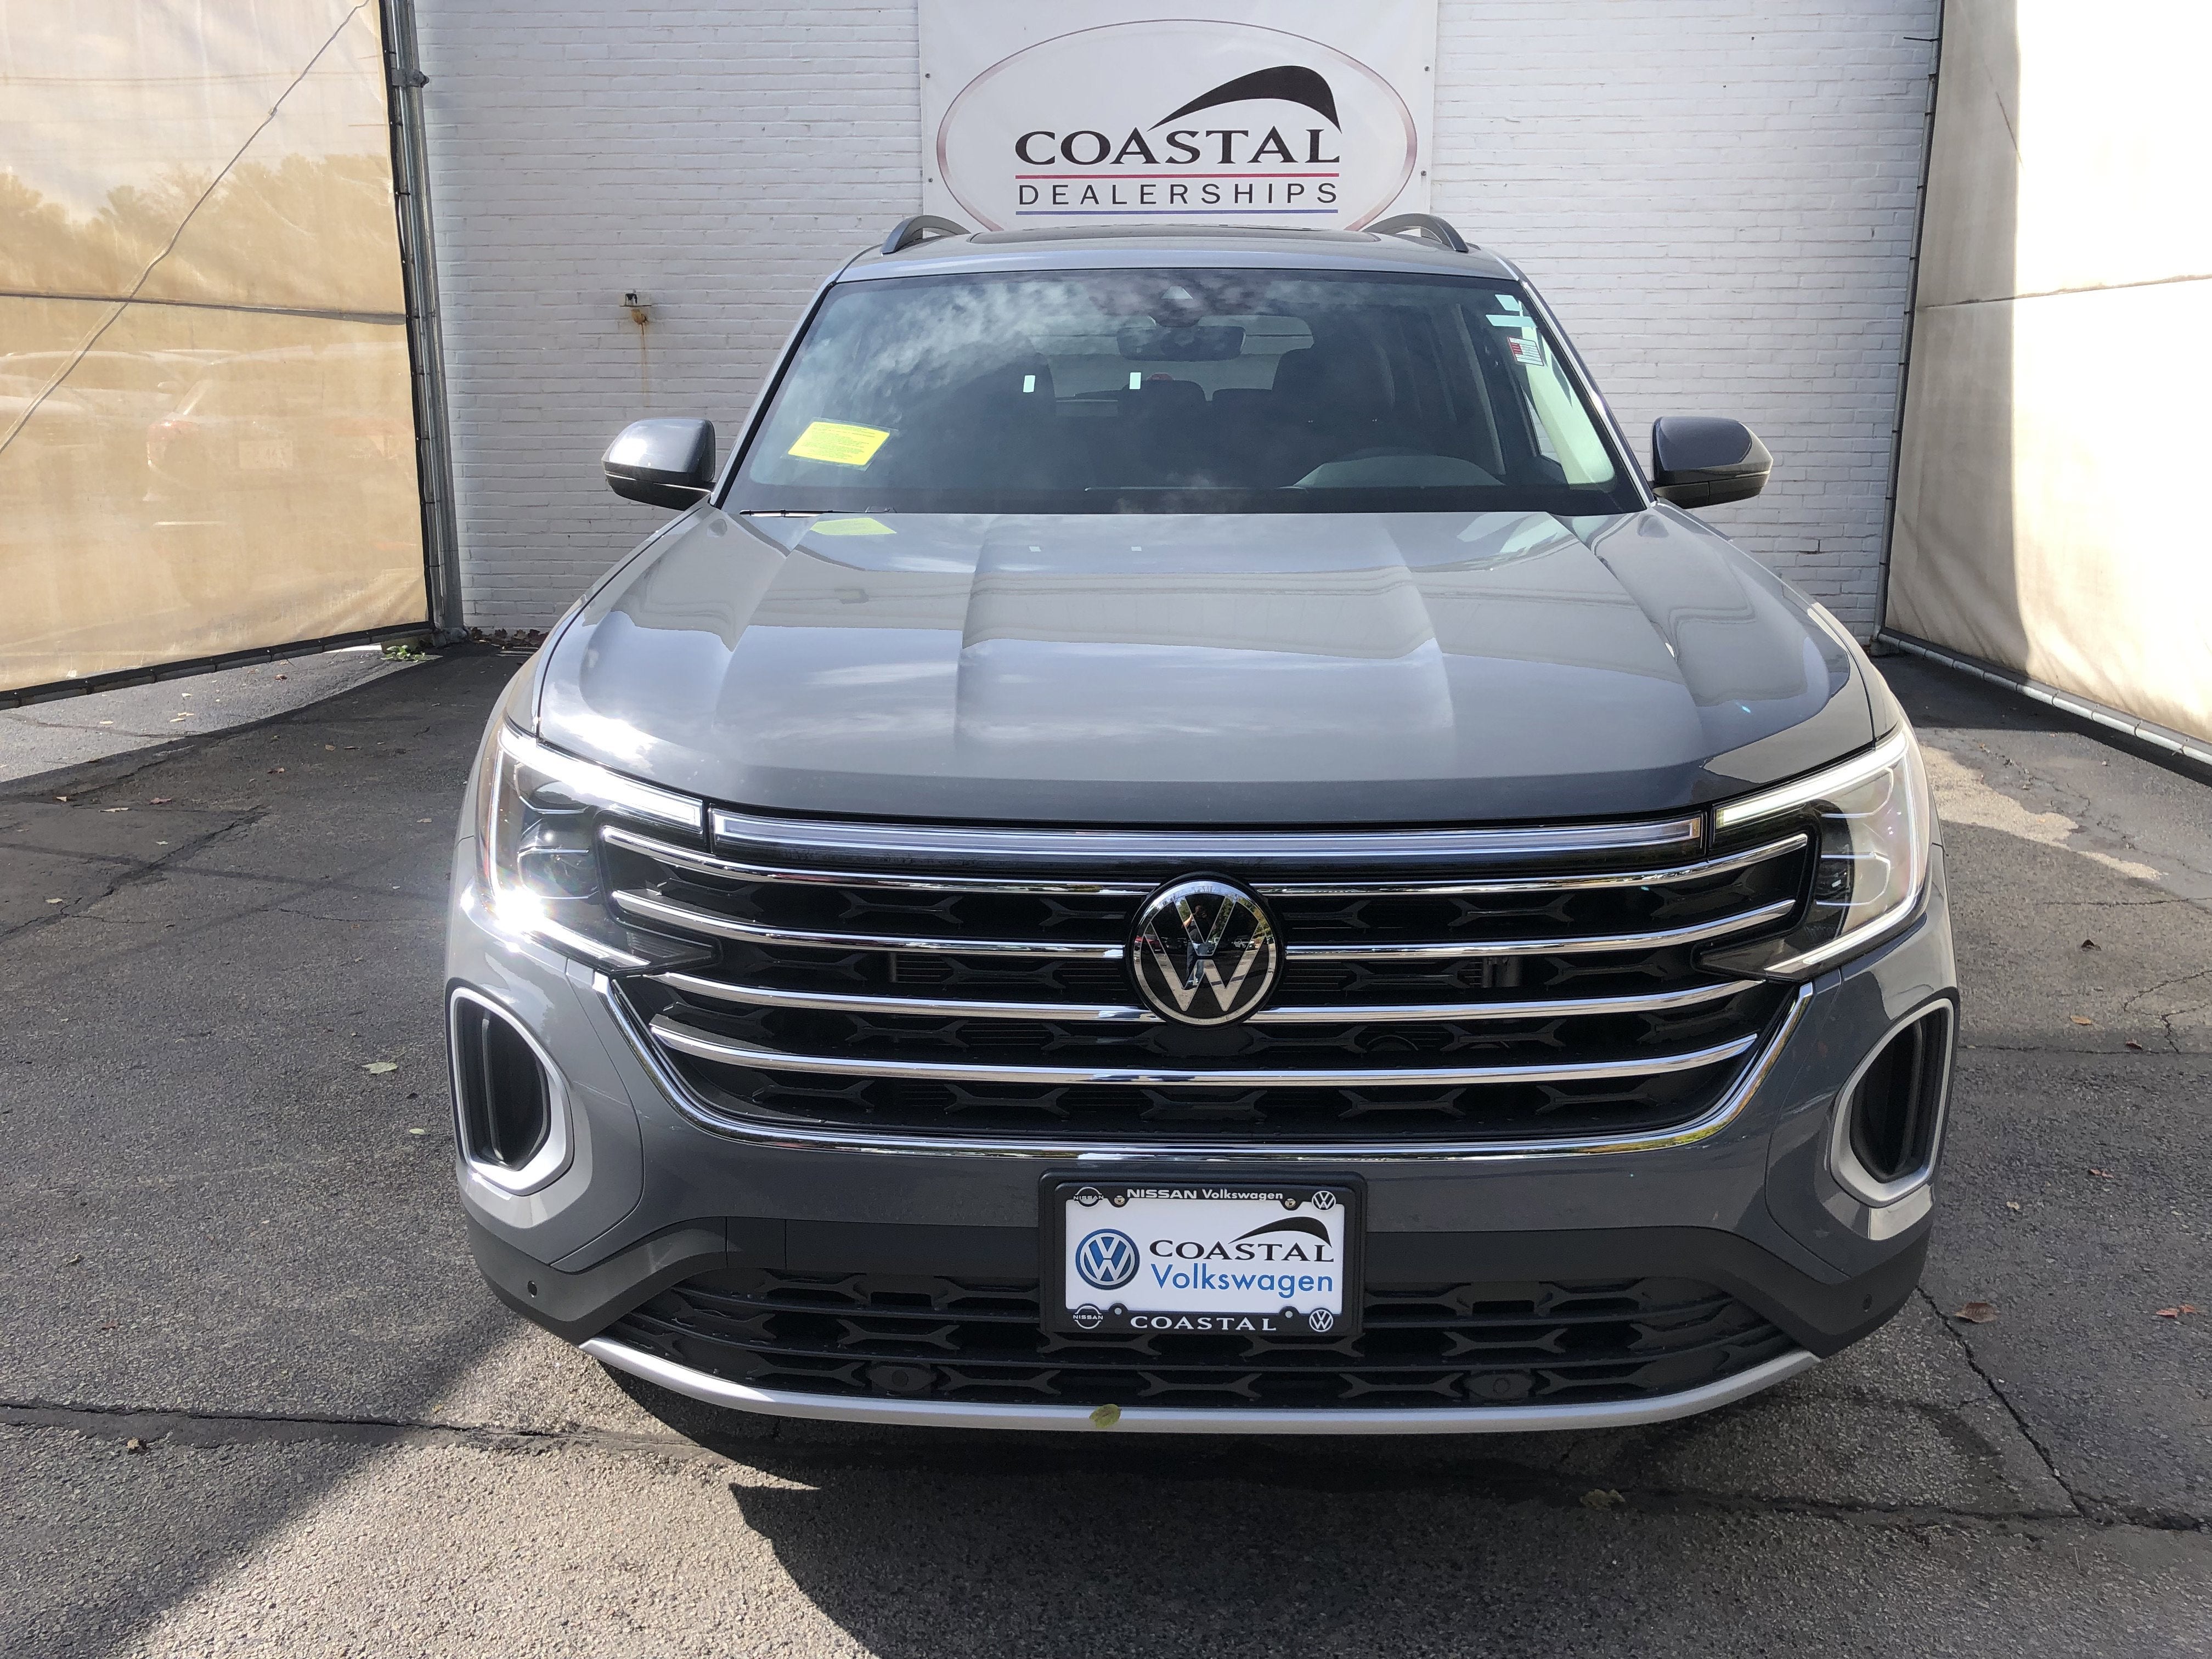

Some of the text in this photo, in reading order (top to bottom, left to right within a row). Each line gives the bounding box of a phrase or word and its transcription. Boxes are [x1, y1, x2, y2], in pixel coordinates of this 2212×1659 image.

[1015, 126, 1340, 165] COASTAL
[1019, 183, 1337, 205] DEALERSHIPS
[1127, 1188, 1283, 1200] NISSAN Volkswagen
[1149, 1239, 1334, 1262] COASTAL
[1150, 1262, 1333, 1299] Volkswagen
[1130, 1316, 1277, 1331] COASTAL
